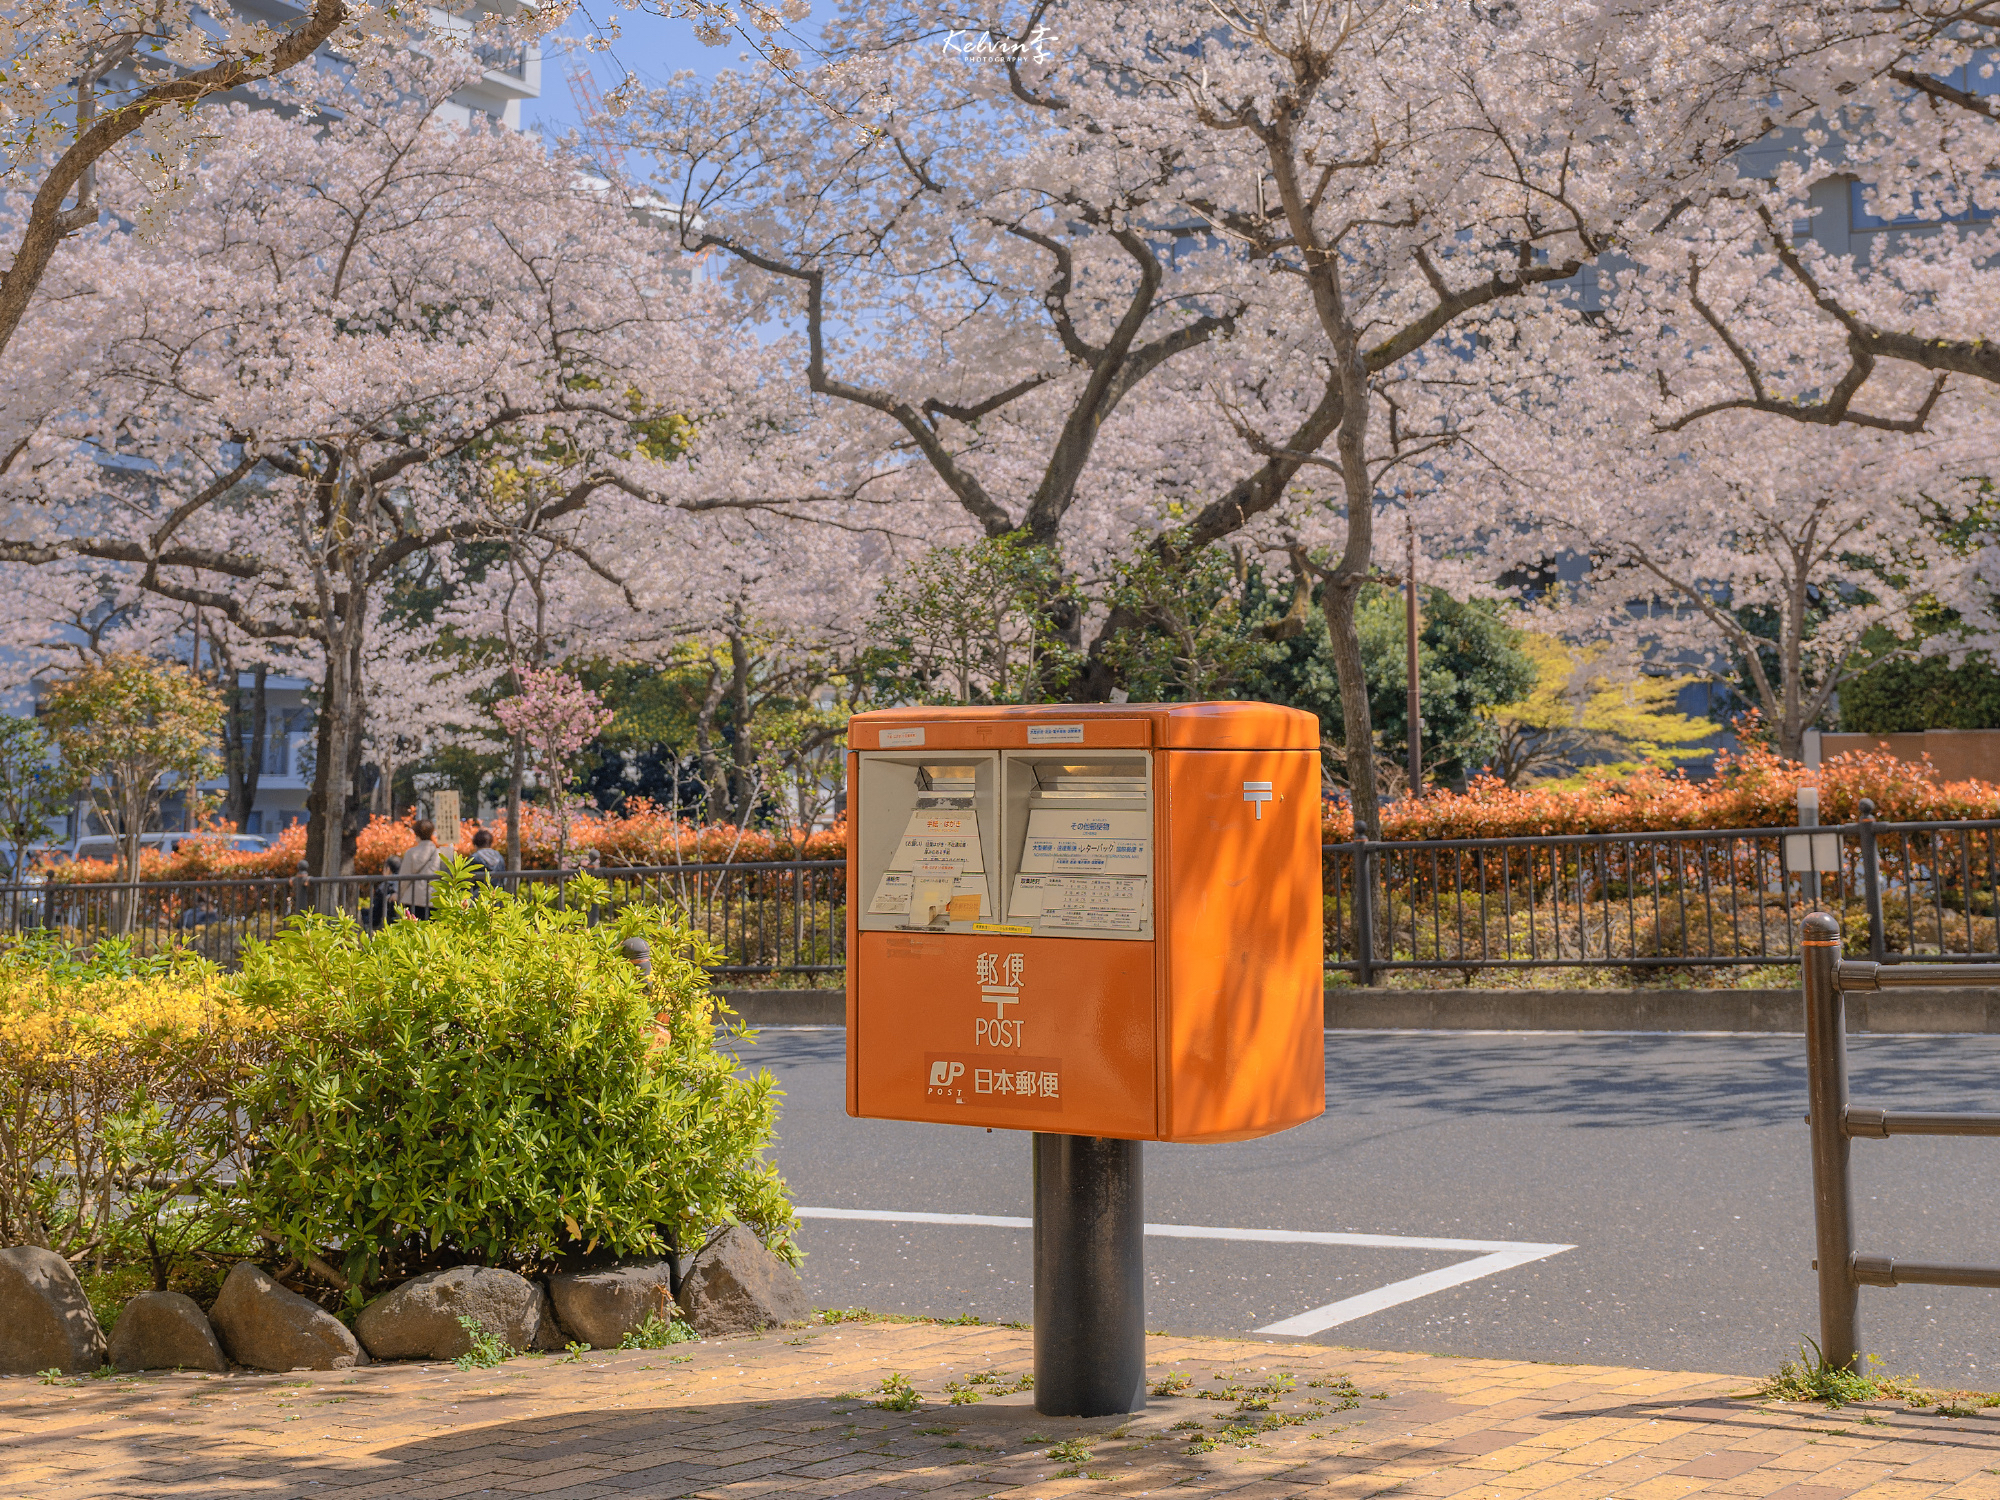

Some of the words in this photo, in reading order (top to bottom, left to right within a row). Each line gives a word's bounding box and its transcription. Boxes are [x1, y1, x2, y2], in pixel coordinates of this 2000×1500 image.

[926, 820, 962, 828] 手紙・はがき
[1070, 822, 1110, 831] その他郵便物
[976, 952, 1025, 987] 郵便
[975, 1018, 1025, 1048] POST
[927, 1087, 963, 1096] POST
[974, 1068, 1060, 1098] 日本郵便
